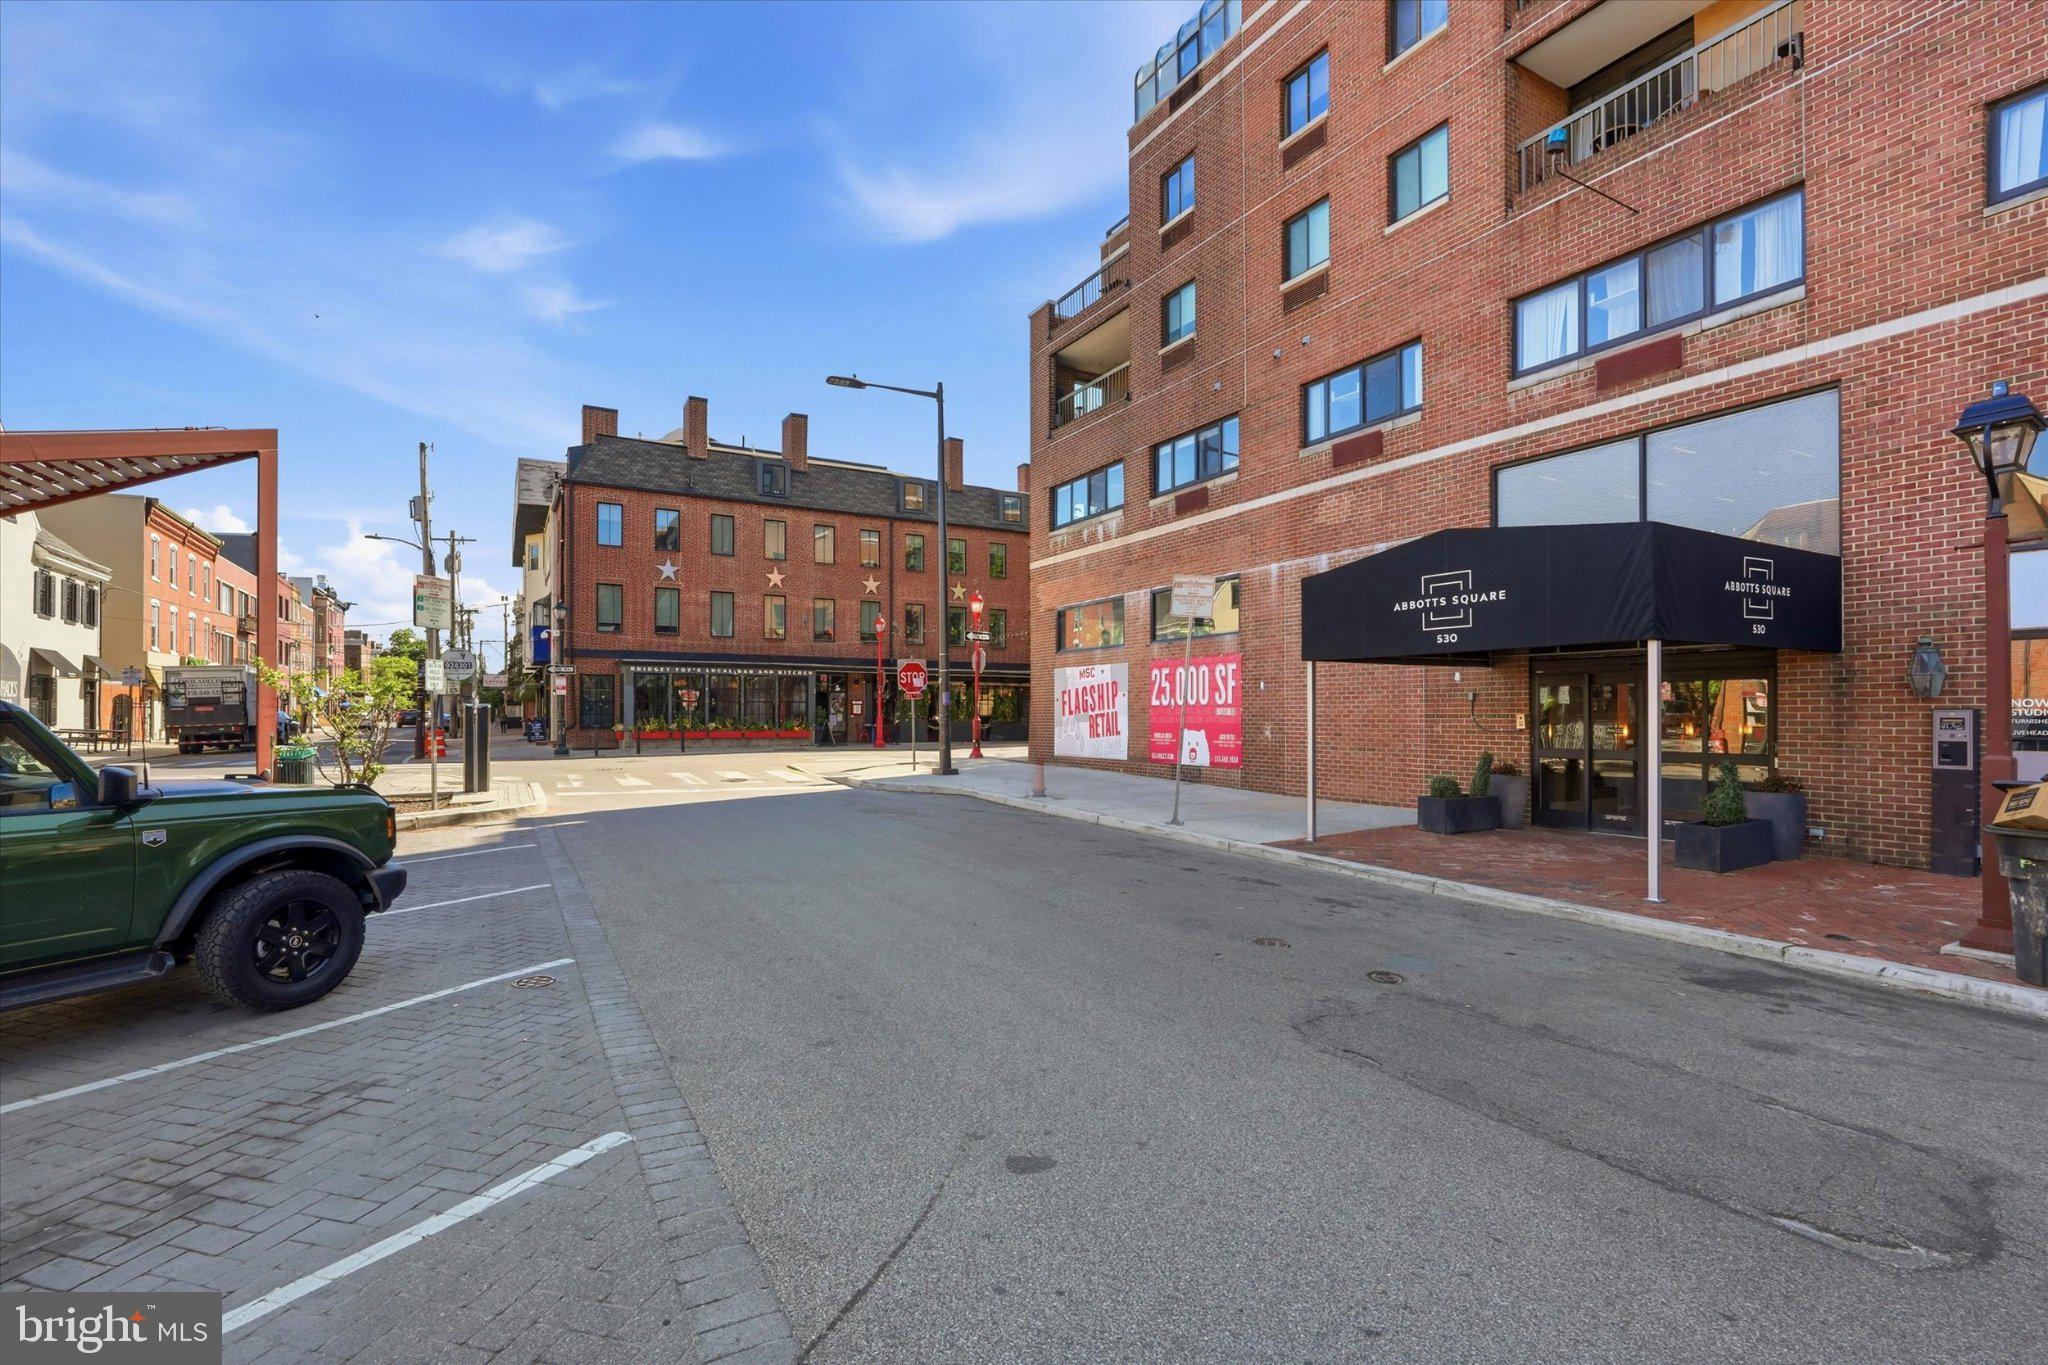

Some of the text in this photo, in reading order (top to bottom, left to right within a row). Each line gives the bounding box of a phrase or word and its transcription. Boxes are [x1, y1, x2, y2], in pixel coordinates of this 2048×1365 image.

[1724, 581, 1791, 597] ABBOTTS SQUARE
[1393, 590, 1506, 612] ABBOTTS SQUARE
[1752, 624, 1766, 634] 530
[1437, 633, 1458, 644] 530
[900, 672, 925, 684] STOP
[1079, 667, 1095, 680] MSC
[1151, 663, 1237, 709] 25,000 SF
[1061, 681, 1118, 716] FLAGSHIP
[2011, 698, 2048, 707] NOW
[2011, 708, 2048, 716] STUDI
[1089, 711, 1121, 738] RETAIL
